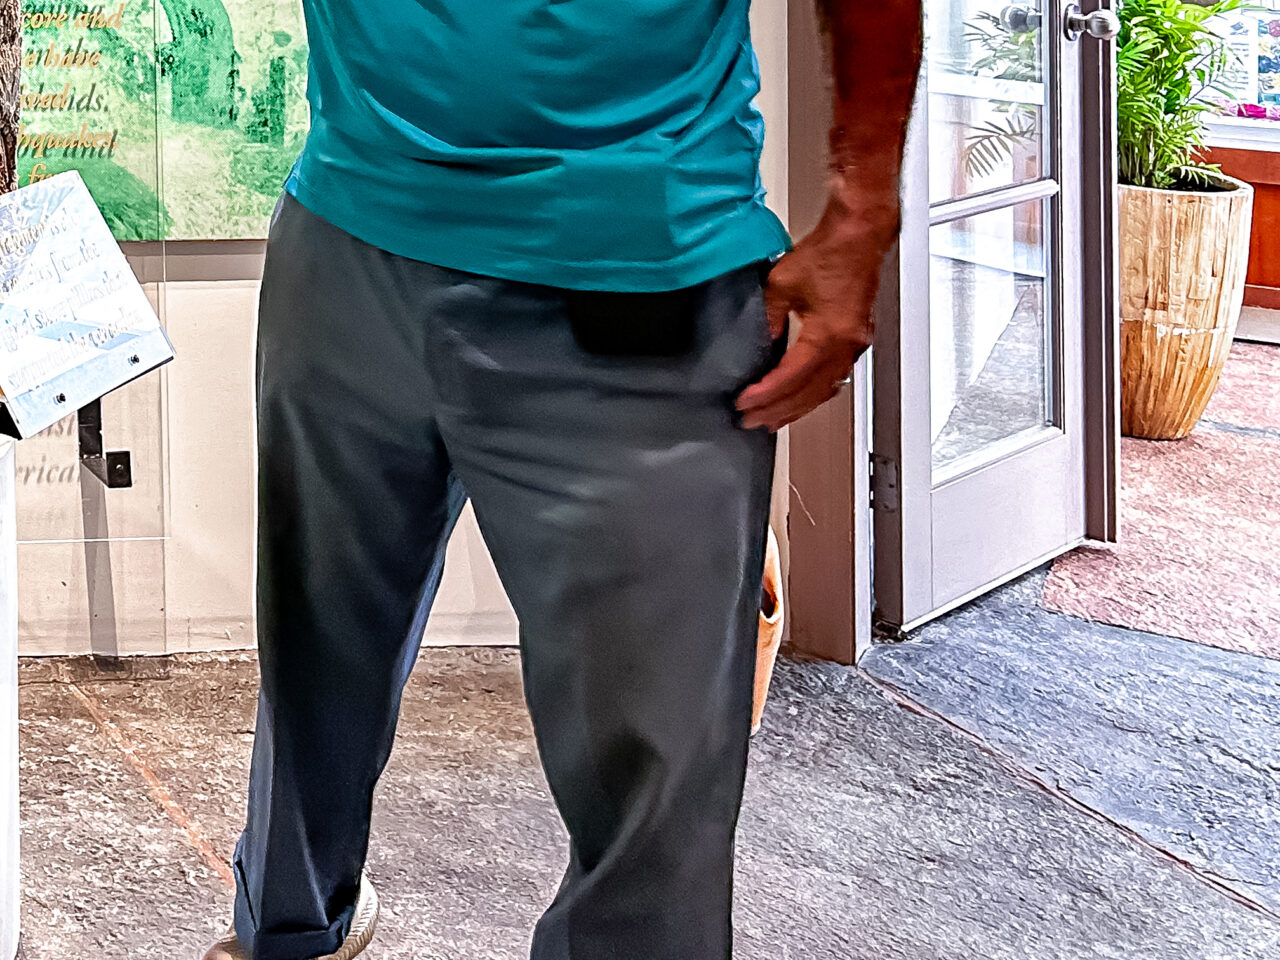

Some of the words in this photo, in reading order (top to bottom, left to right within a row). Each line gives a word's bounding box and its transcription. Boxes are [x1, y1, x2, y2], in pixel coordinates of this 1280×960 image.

[74, 2, 125, 29] and
[43, 42, 102, 69] have
[18, 122, 118, 159] hquakes,
